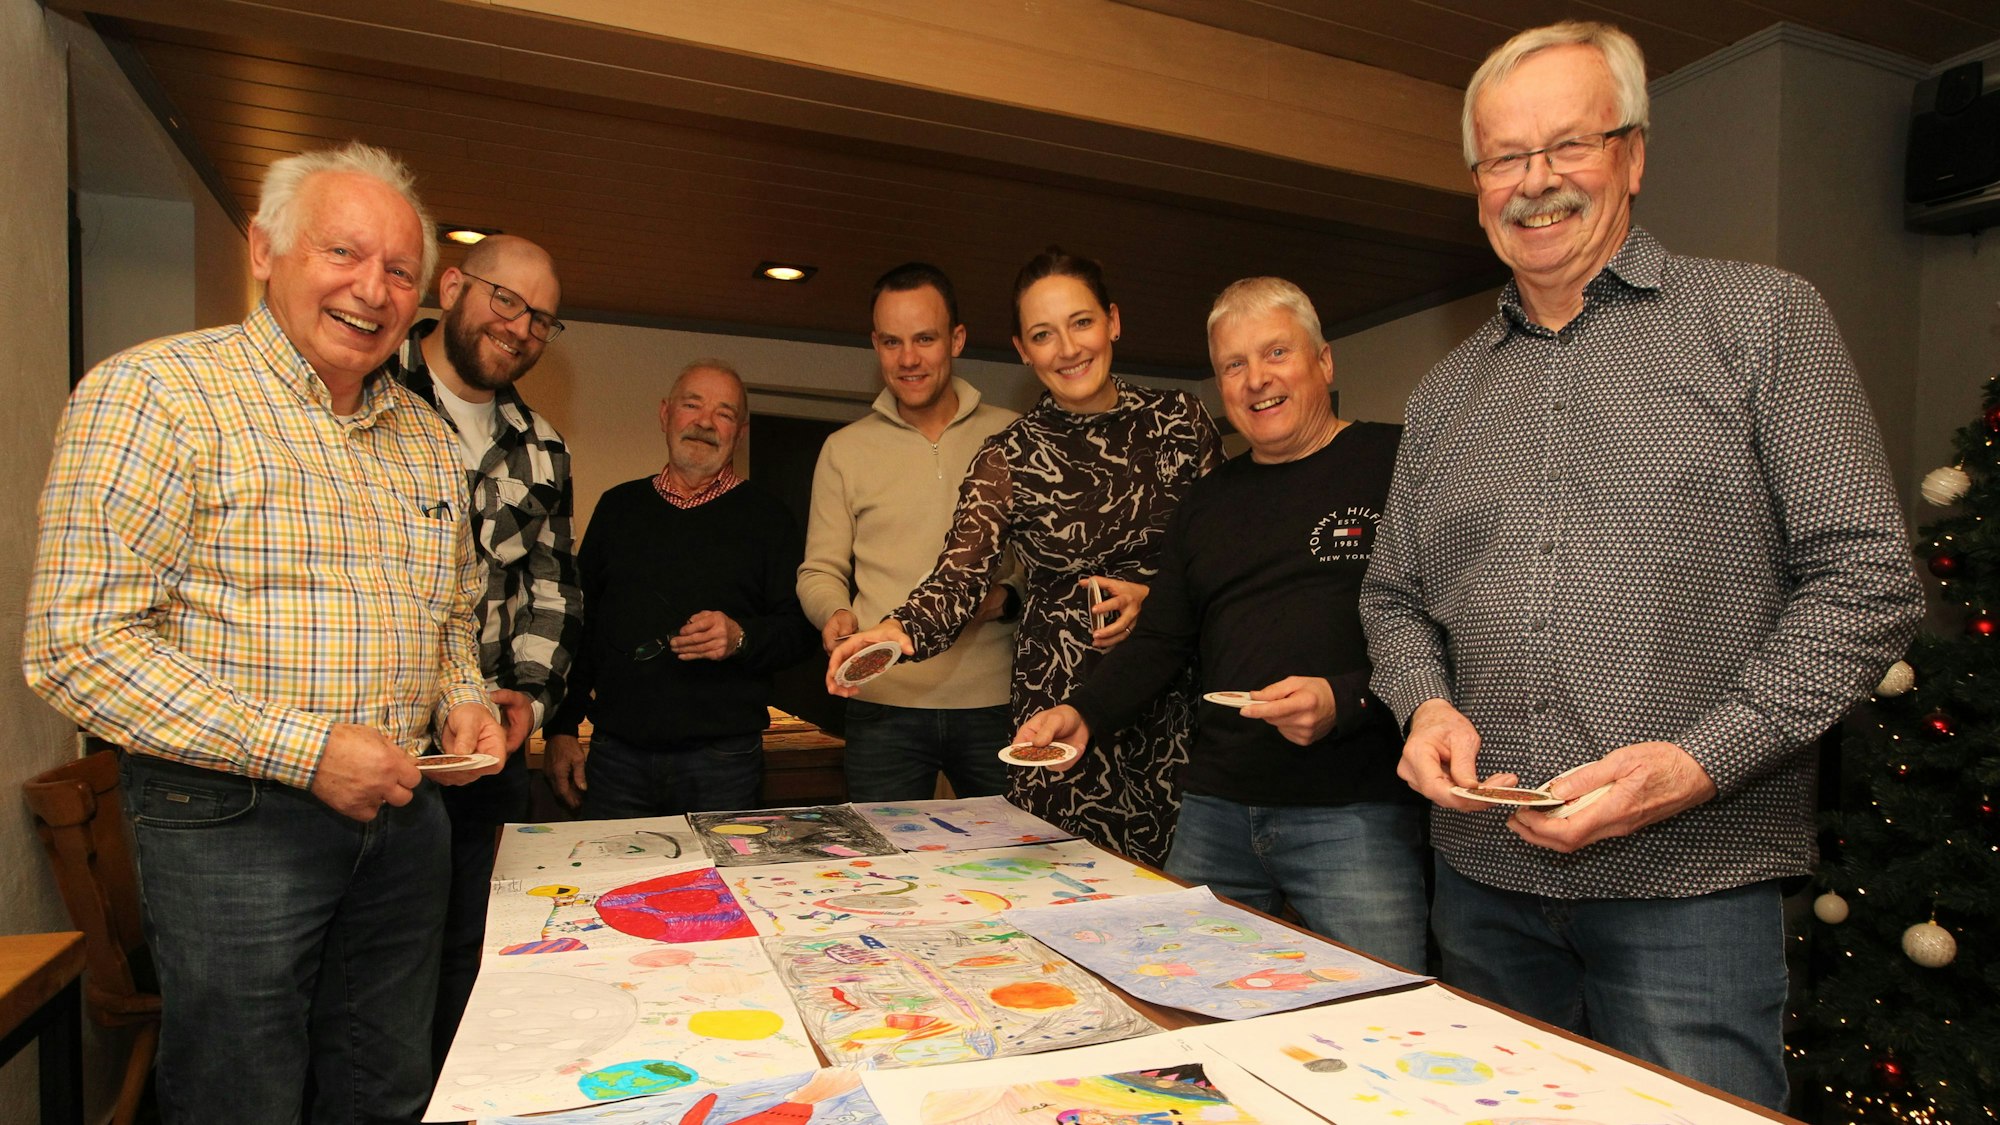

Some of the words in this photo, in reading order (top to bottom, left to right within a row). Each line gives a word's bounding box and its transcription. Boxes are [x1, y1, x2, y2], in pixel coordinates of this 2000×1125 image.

[1337, 518, 1360, 526] EST.
[1309, 510, 1337, 555] TOMMY
[1334, 540, 1359, 548] 1985
[1319, 554, 1341, 563] NEW
[1345, 553, 1371, 561] YORK
